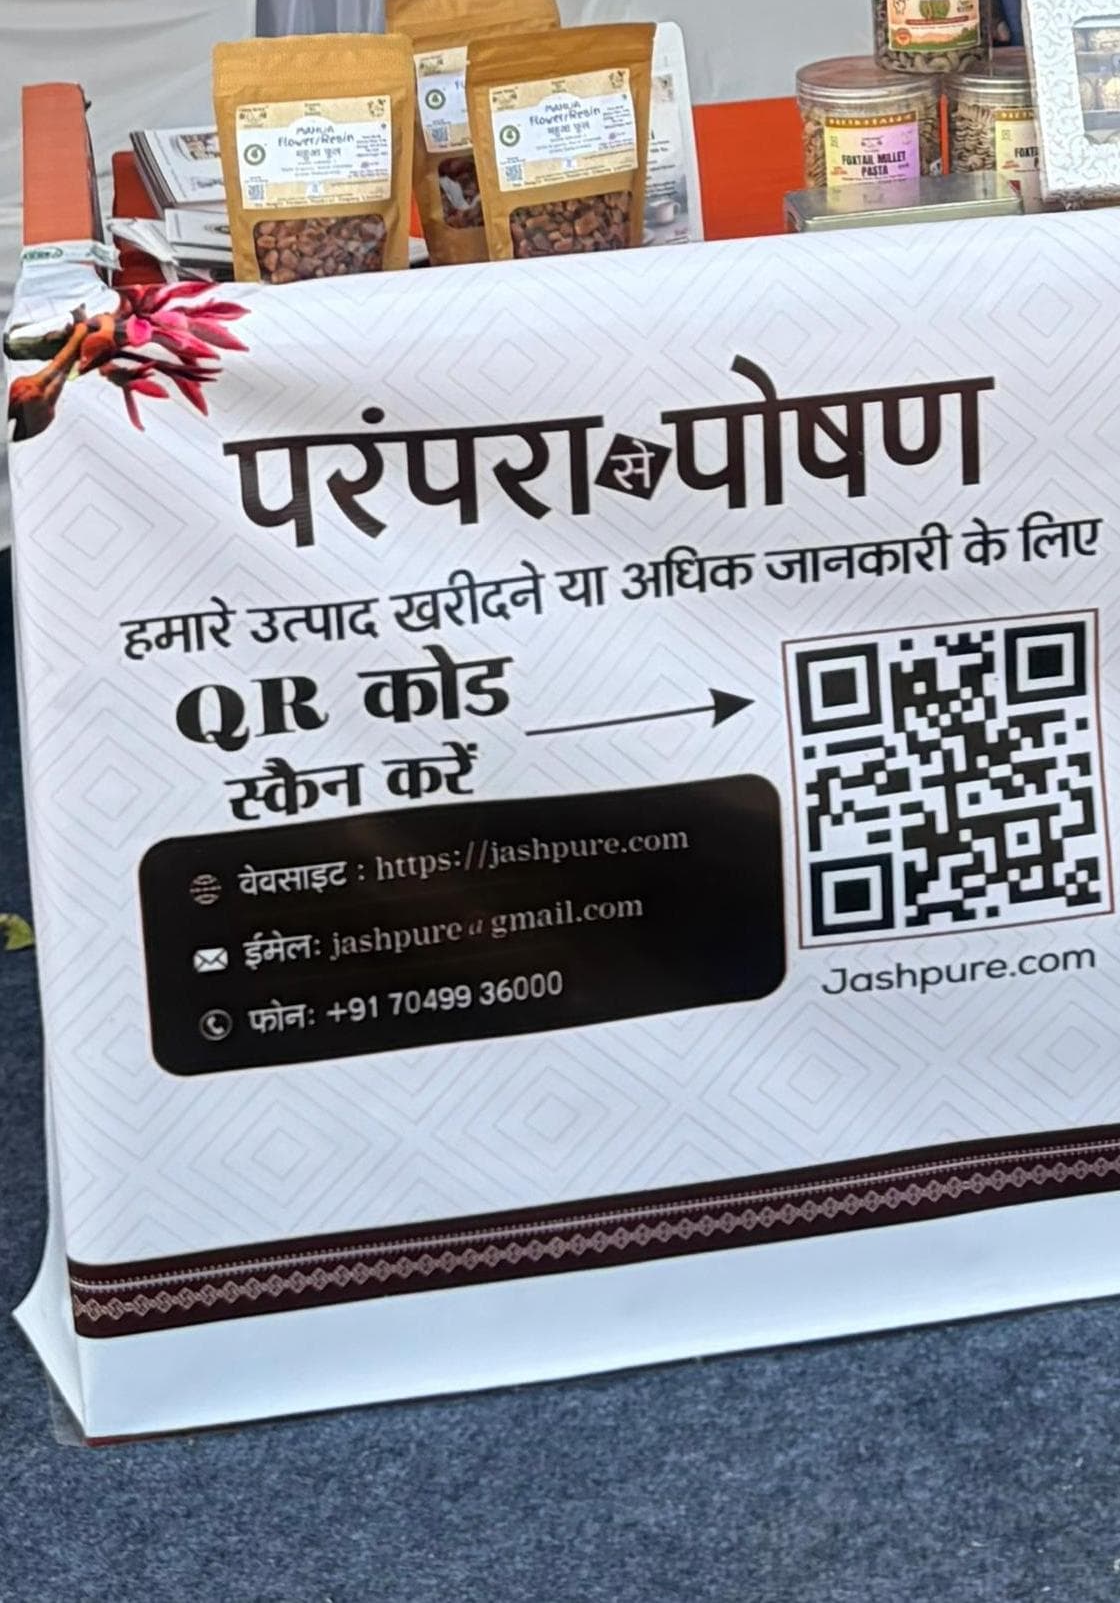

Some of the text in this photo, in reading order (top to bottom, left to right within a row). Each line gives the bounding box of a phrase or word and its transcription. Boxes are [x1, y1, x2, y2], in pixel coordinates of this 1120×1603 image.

[841, 150, 906, 166] FOXTAIL MILLET
[861, 165, 889, 177] PASTA
[222, 353, 996, 549] परंपरा से पोषण
[120, 510, 1105, 661] हमारे उत्पाद खरीदने या अधिक जानकारी के लिए
[174, 644, 514, 752] QR कोड
[223, 741, 479, 822] स्कैन करें
[375, 826, 690, 883] https://jashpure.com
[242, 930, 321, 970] ईमेल:
[821, 947, 1097, 995] Jashpure.com
[248, 970, 565, 1036] फोन: +91 70499 36000
